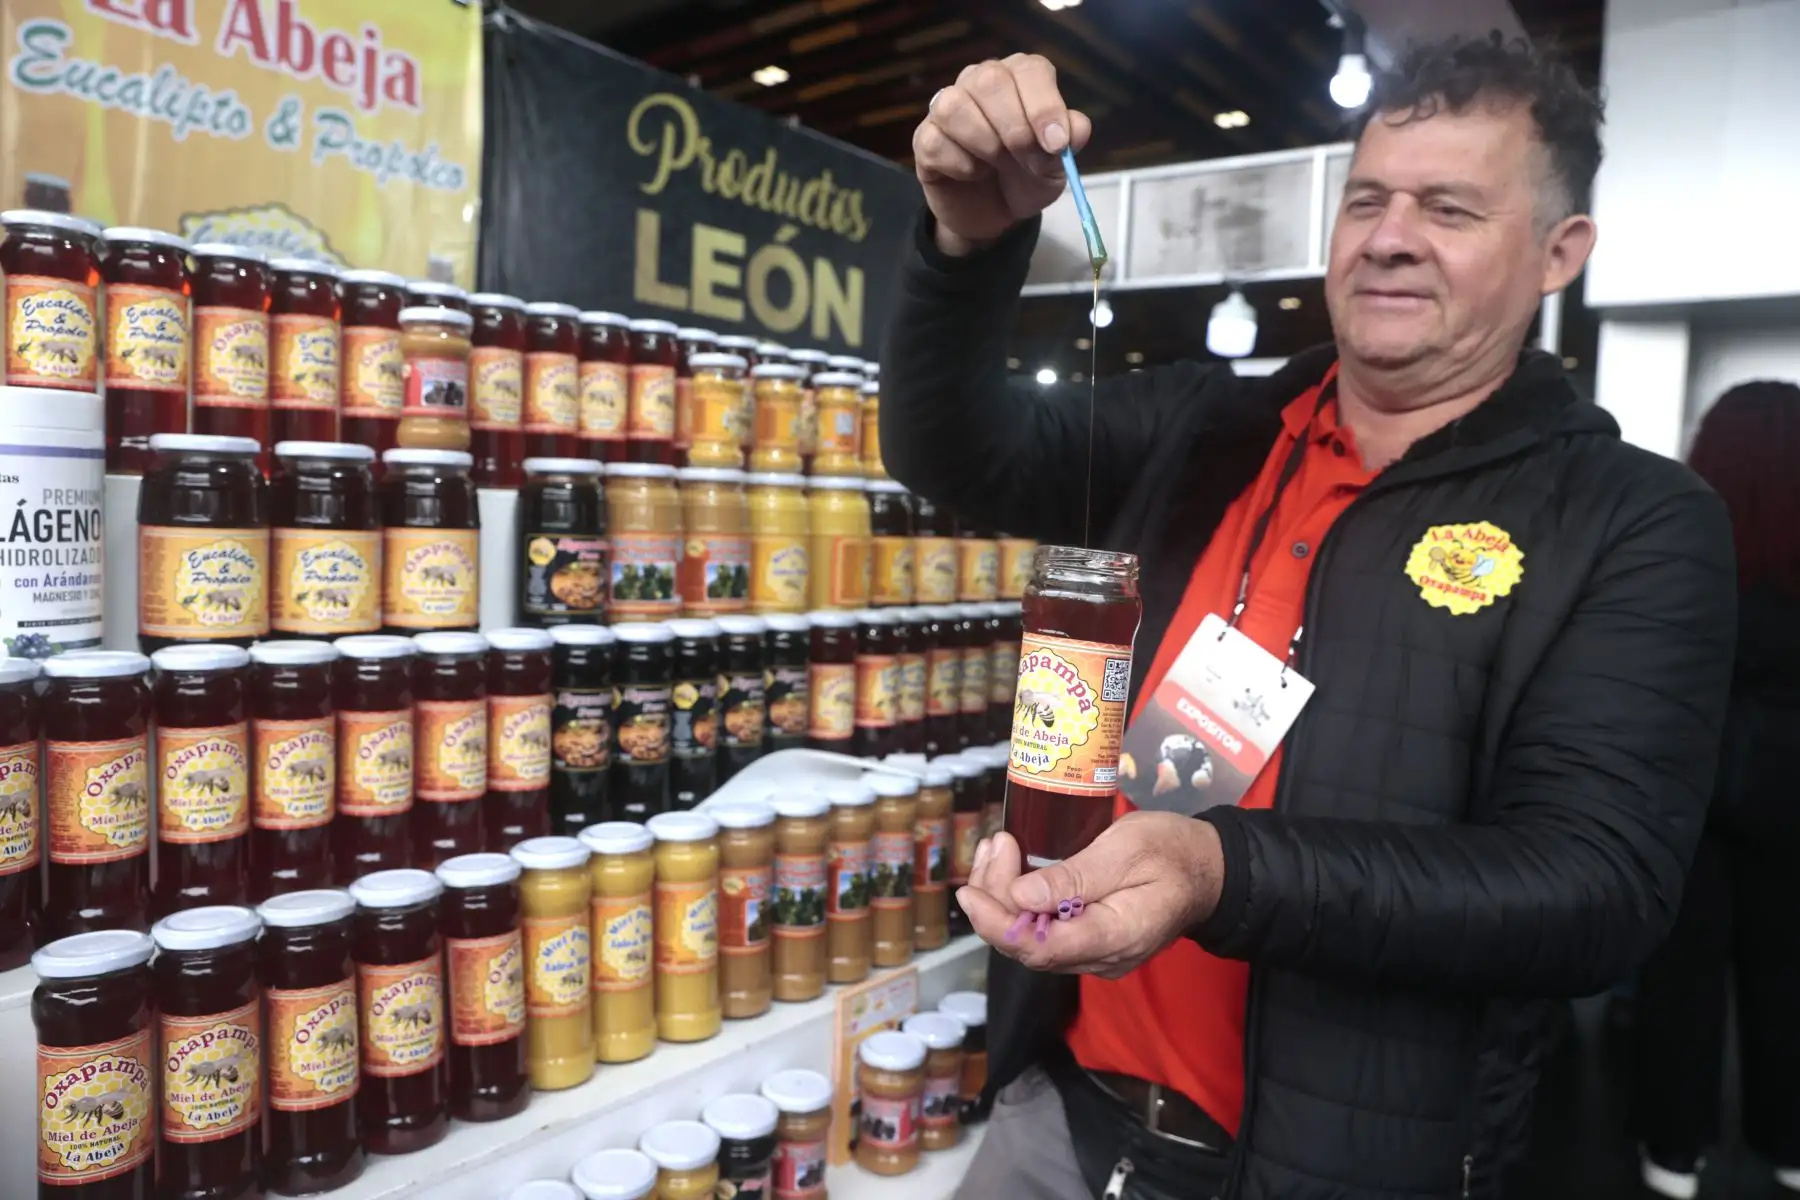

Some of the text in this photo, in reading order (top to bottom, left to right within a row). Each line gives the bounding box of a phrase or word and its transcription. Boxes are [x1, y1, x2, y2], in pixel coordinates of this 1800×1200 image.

[221, 0, 419, 109] Abeja
[14, 24, 249, 138] Eucalipto
[271, 100, 299, 146] &
[626, 92, 872, 243] Productos
[632, 208, 866, 347] LEÓN
[14, 577, 38, 588] con
[1033, 730, 1069, 746] Abeja
[1019, 750, 1050, 766] Abeja
[92, 814, 120, 826] Miel
[4, 840, 32, 856] Abeja
[45, 1059, 149, 1110] Oxapampa
[171, 1081, 250, 1103] Miel de Abeja
[188, 1103, 239, 1122] La Abeja
[48, 1117, 138, 1142] Miel de Abeja
[65, 1142, 124, 1162] La Abeja
[69, 1135, 121, 1150] 100% NATURAL
